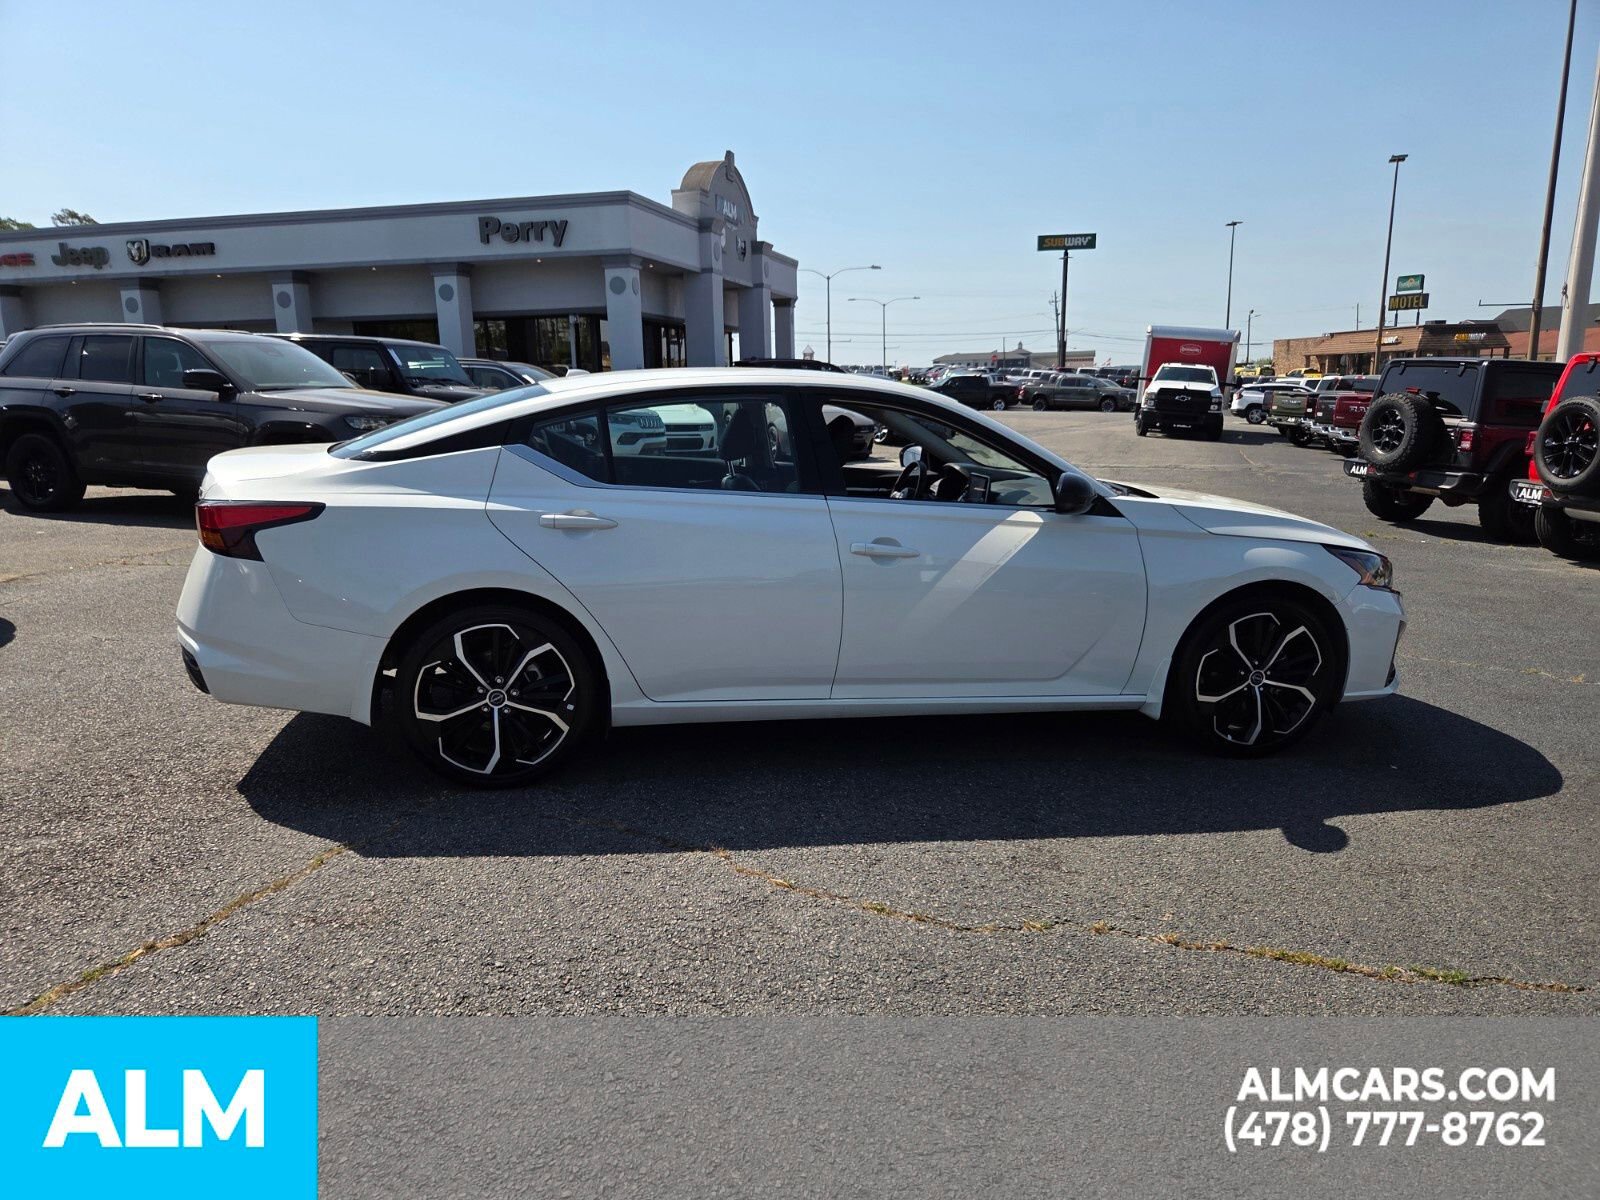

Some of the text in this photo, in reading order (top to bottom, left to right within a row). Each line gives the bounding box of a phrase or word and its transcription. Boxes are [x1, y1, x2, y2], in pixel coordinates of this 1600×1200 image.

[478, 216, 568, 248] Perry
[1043, 236, 1091, 248] SUBWAY
[51, 242, 110, 270] Jeep
[151, 243, 215, 257] RAM
[1390, 295, 1425, 309] MOTEL
[1350, 464, 1368, 475] ALM
[1518, 487, 1542, 500] ALM
